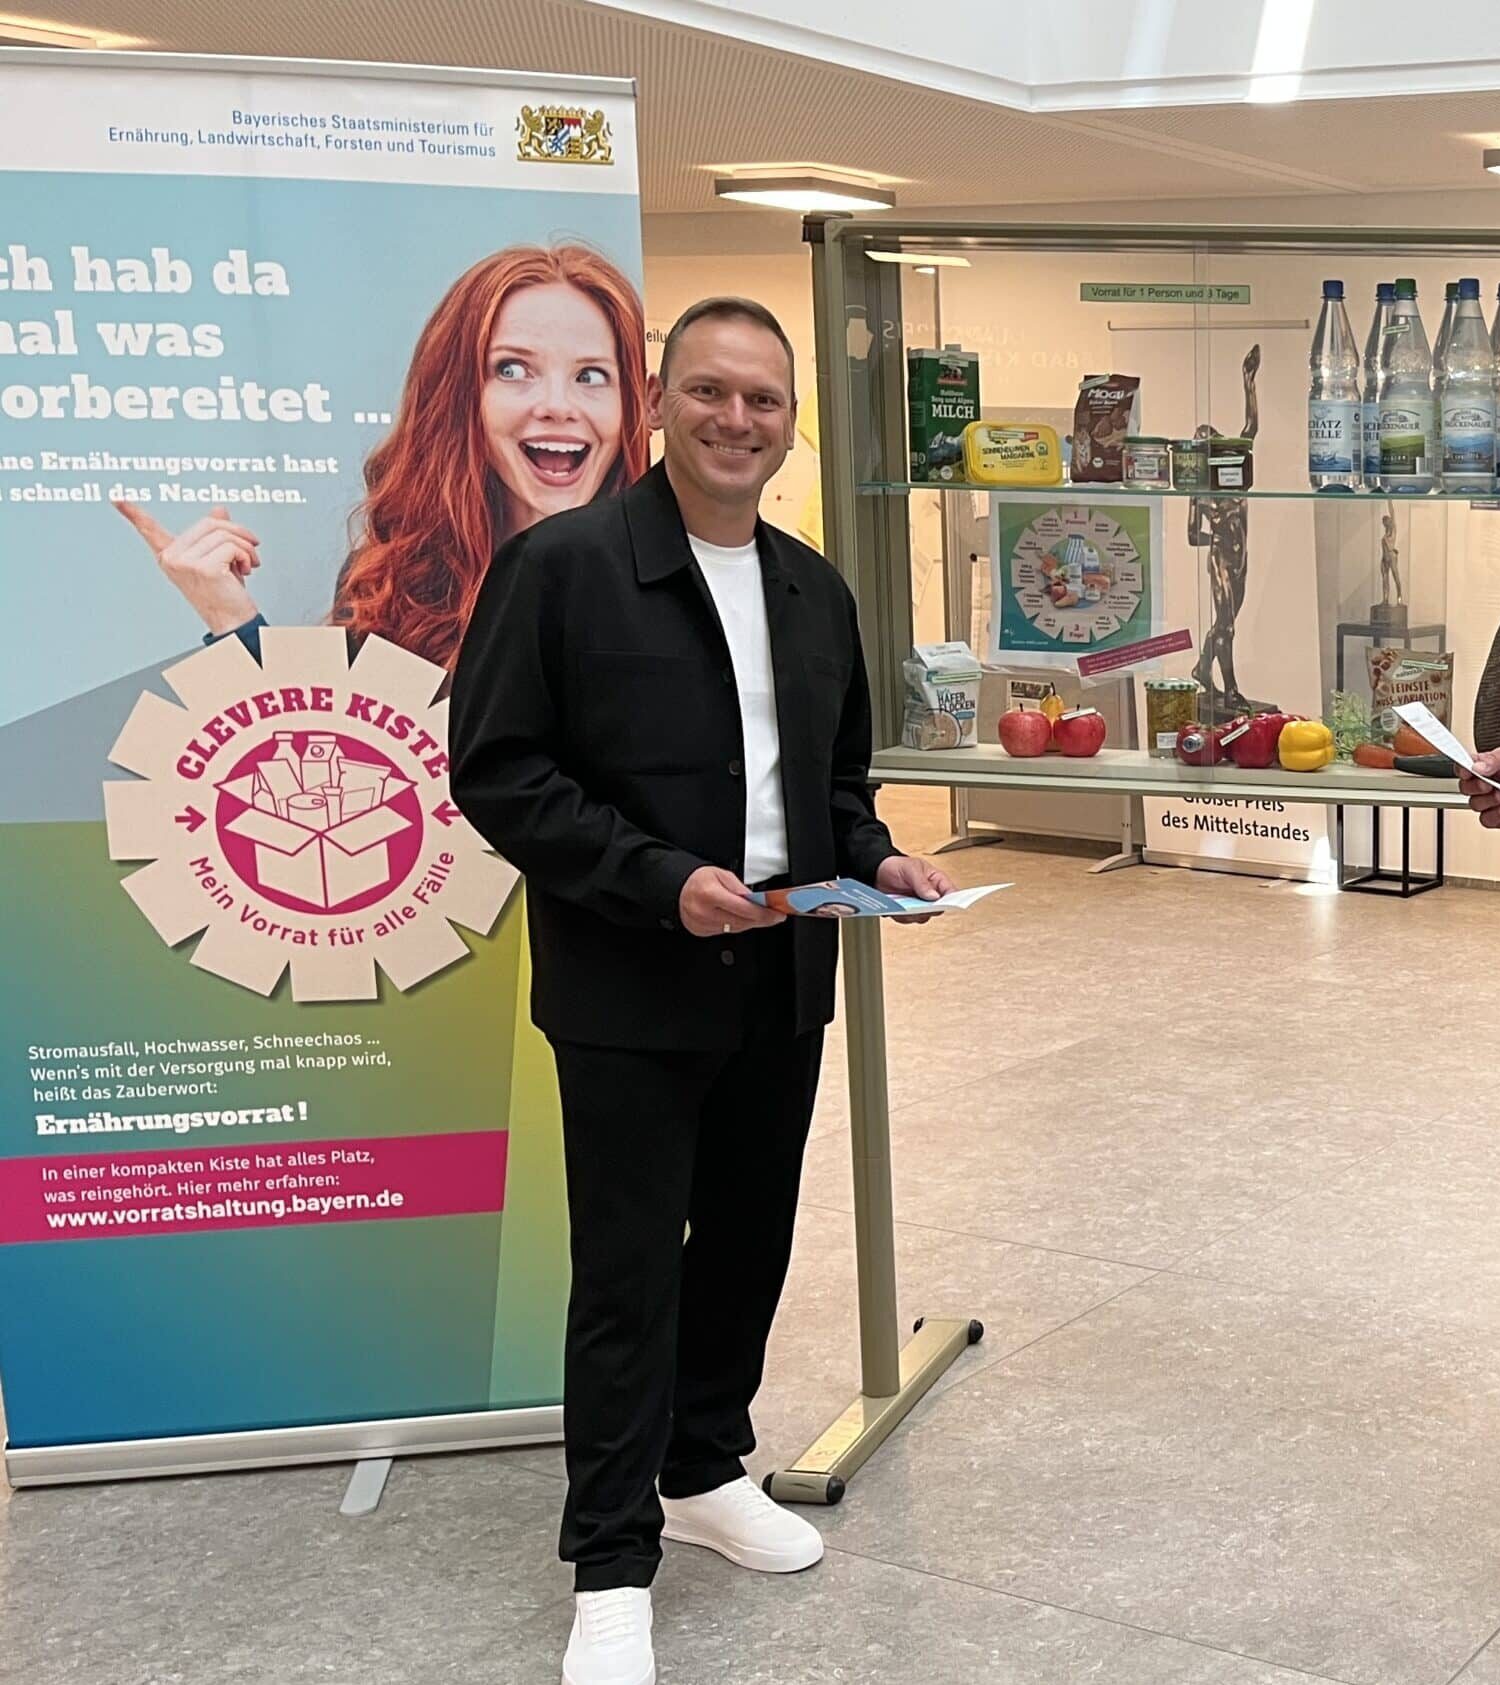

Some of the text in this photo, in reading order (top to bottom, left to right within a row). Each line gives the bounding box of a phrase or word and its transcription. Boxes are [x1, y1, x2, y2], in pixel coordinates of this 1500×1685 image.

[232, 110, 494, 138] Bayerisches Staatsministerium für
[108, 127, 496, 158] Ernährung, Landwirtschaft, Forsten und Tourismus
[71, 246, 192, 294] hab
[213, 249, 290, 296] da
[1091, 287, 1121, 297] Vorrat
[1123, 287, 1136, 297] für
[1148, 287, 1183, 298] Person
[1185, 288, 1203, 298] und
[1217, 288, 1240, 301] Tage
[97, 322, 224, 358] was
[1, 374, 332, 423] orbereitet
[931, 404, 975, 419] MILCH
[0, 451, 339, 476] ne Ernährungsvorrat hast
[10, 483, 306, 503] schnell das Nachsehen.
[176, 686, 450, 780] CLEVERE KISTE
[1161, 811, 1310, 842] des Mittelstandes
[189, 852, 455, 947] Mein Vorrat für alle Fälle
[28, 1043, 140, 1060] Stromausfall,
[144, 1038, 249, 1056] Hochwasser,
[253, 1032, 362, 1050] Schneechaos
[31, 1052, 391, 1082] Wenn's mit der Versorgung mal knapp wird,
[33, 1080, 218, 1102] heißt das Zauberwort:
[42, 1149, 376, 1182] In einer kompakten Kiste hat alles Platz,
[44, 1173, 340, 1203] was reingehört. Hier mehr erfahren:
[46, 1189, 404, 1228] www.vorratshaltung.bayern.de
